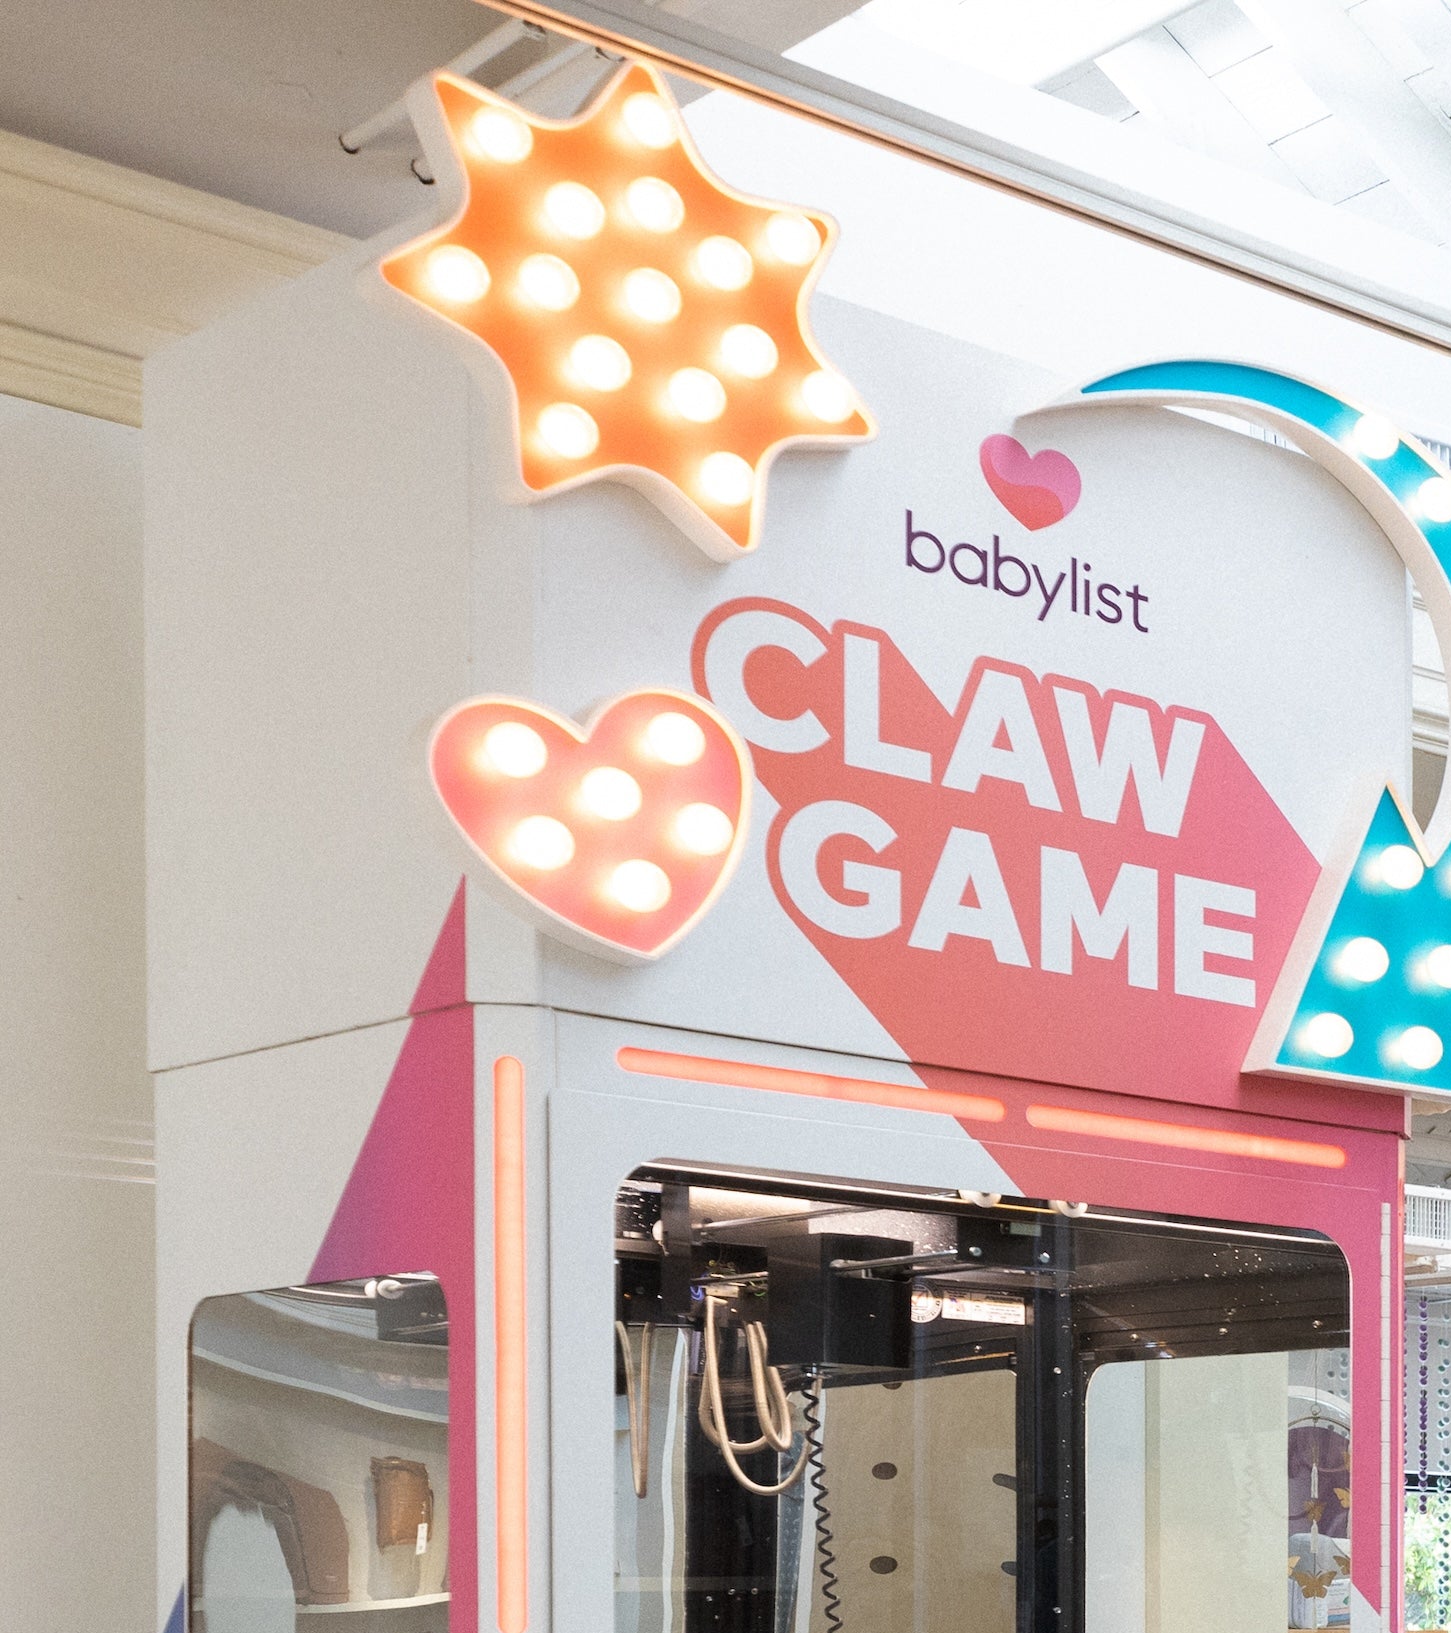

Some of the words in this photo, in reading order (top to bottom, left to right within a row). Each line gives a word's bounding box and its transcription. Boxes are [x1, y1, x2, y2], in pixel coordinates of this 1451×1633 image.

[905, 508, 1149, 633] babylist
[704, 608, 1206, 838] CLAW
[777, 799, 1257, 1008] GAME
